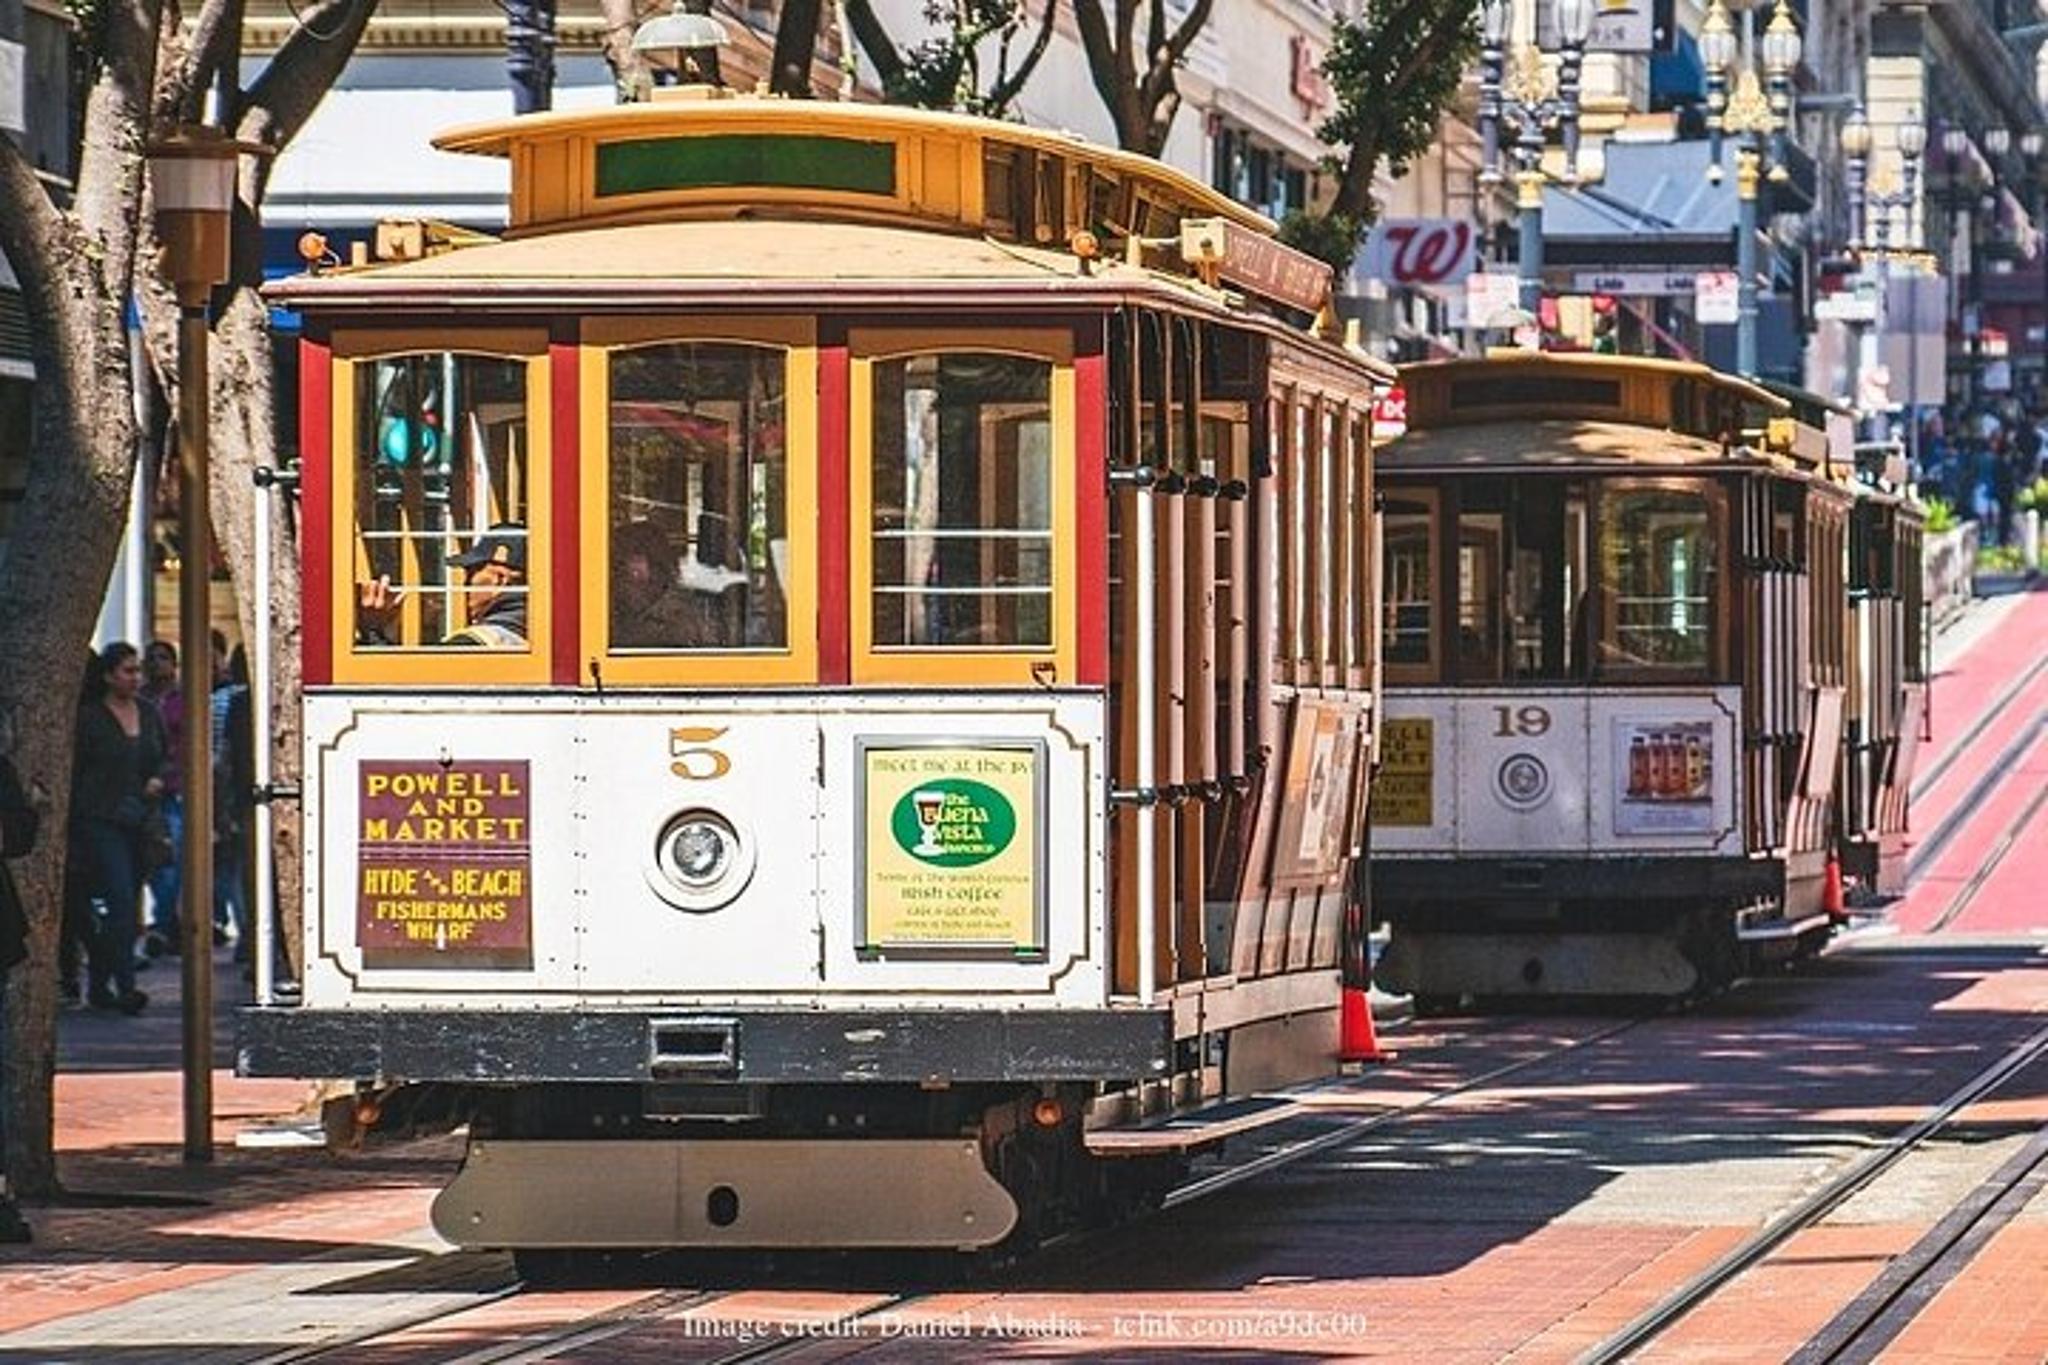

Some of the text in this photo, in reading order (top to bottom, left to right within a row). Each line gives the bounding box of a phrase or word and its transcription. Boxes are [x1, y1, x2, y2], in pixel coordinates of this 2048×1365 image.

[1493, 705, 1551, 737] 19
[668, 726, 732, 780] 5
[367, 773, 521, 797] POWELL
[408, 798, 484, 817] AND
[365, 818, 525, 842] MARKET
[364, 868, 419, 895] HYDE
[451, 868, 522, 897] BEACH
[376, 900, 508, 920] FISHERMANS
